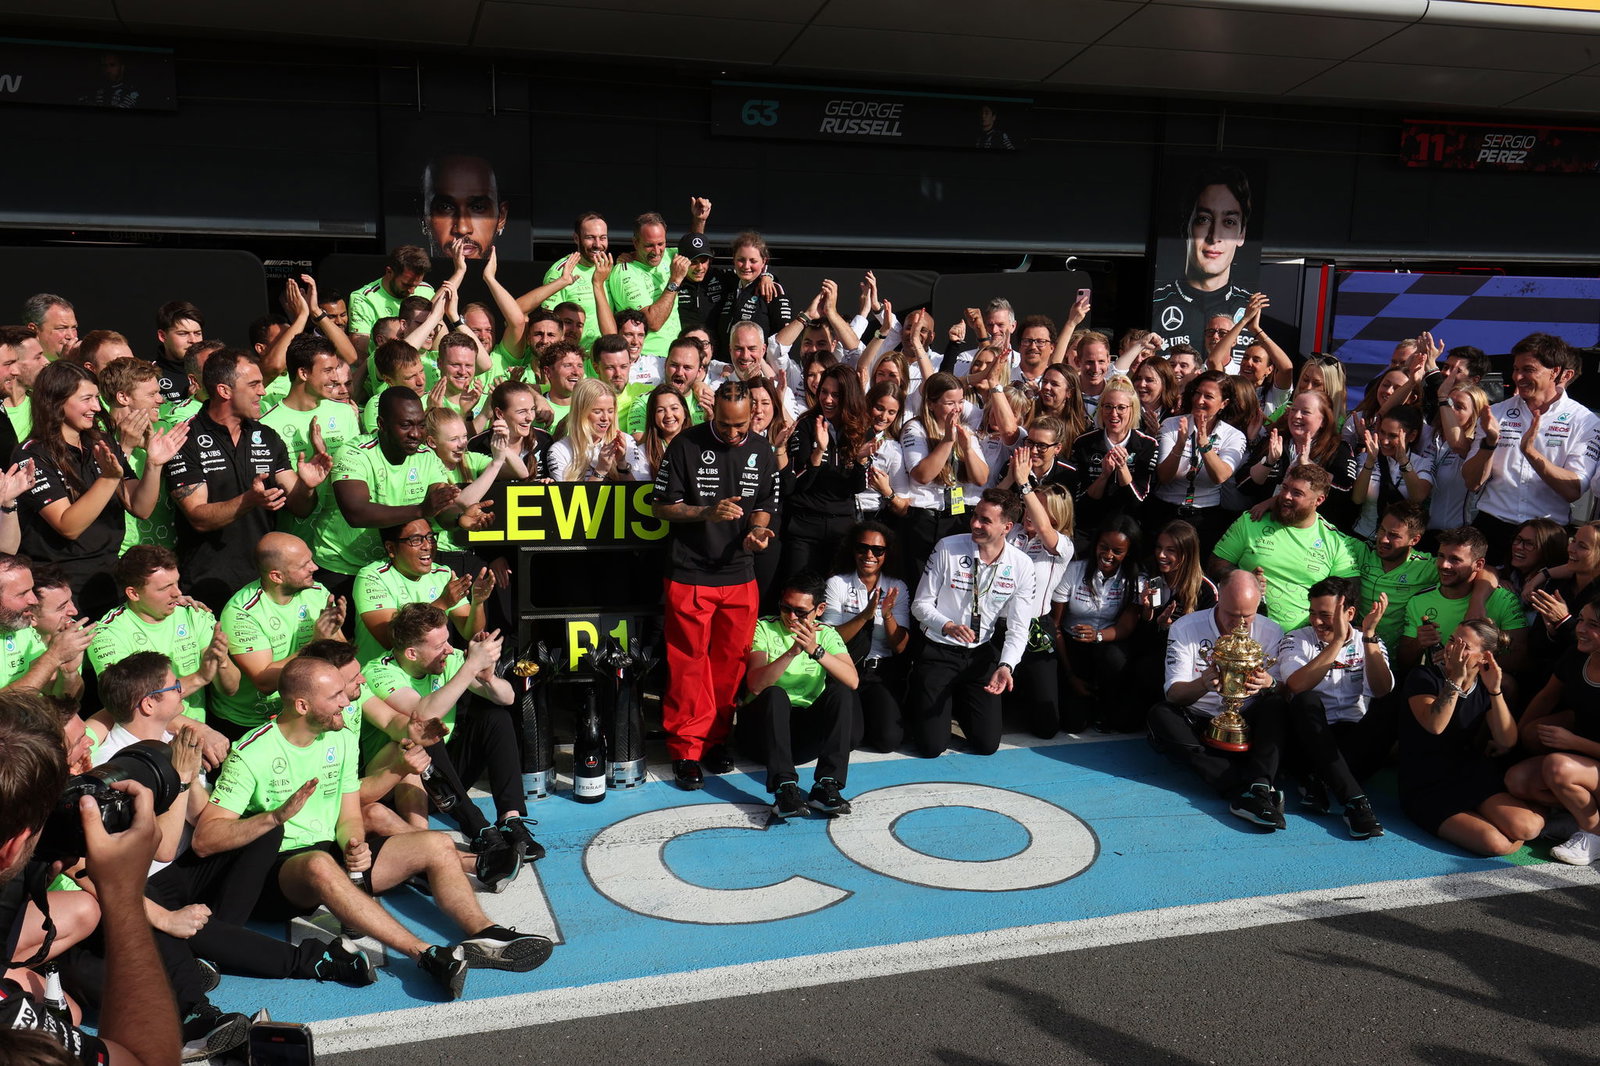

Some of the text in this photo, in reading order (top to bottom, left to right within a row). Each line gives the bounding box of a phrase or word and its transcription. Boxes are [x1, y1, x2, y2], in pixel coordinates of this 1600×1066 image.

[741, 100, 779, 126] 63
[825, 101, 904, 118] GEORGE
[820, 118, 902, 137] RUSSELL
[1416, 133, 1446, 162] 11
[1481, 134, 1537, 149] SERGIO
[1477, 149, 1529, 164] PEREZ
[1170, 335, 1190, 346] UBS
[207, 449, 221, 457] UBS
[742, 472, 759, 480] INEOS
[996, 580, 1015, 589] INEOS
[277, 779, 290, 787] UBS
